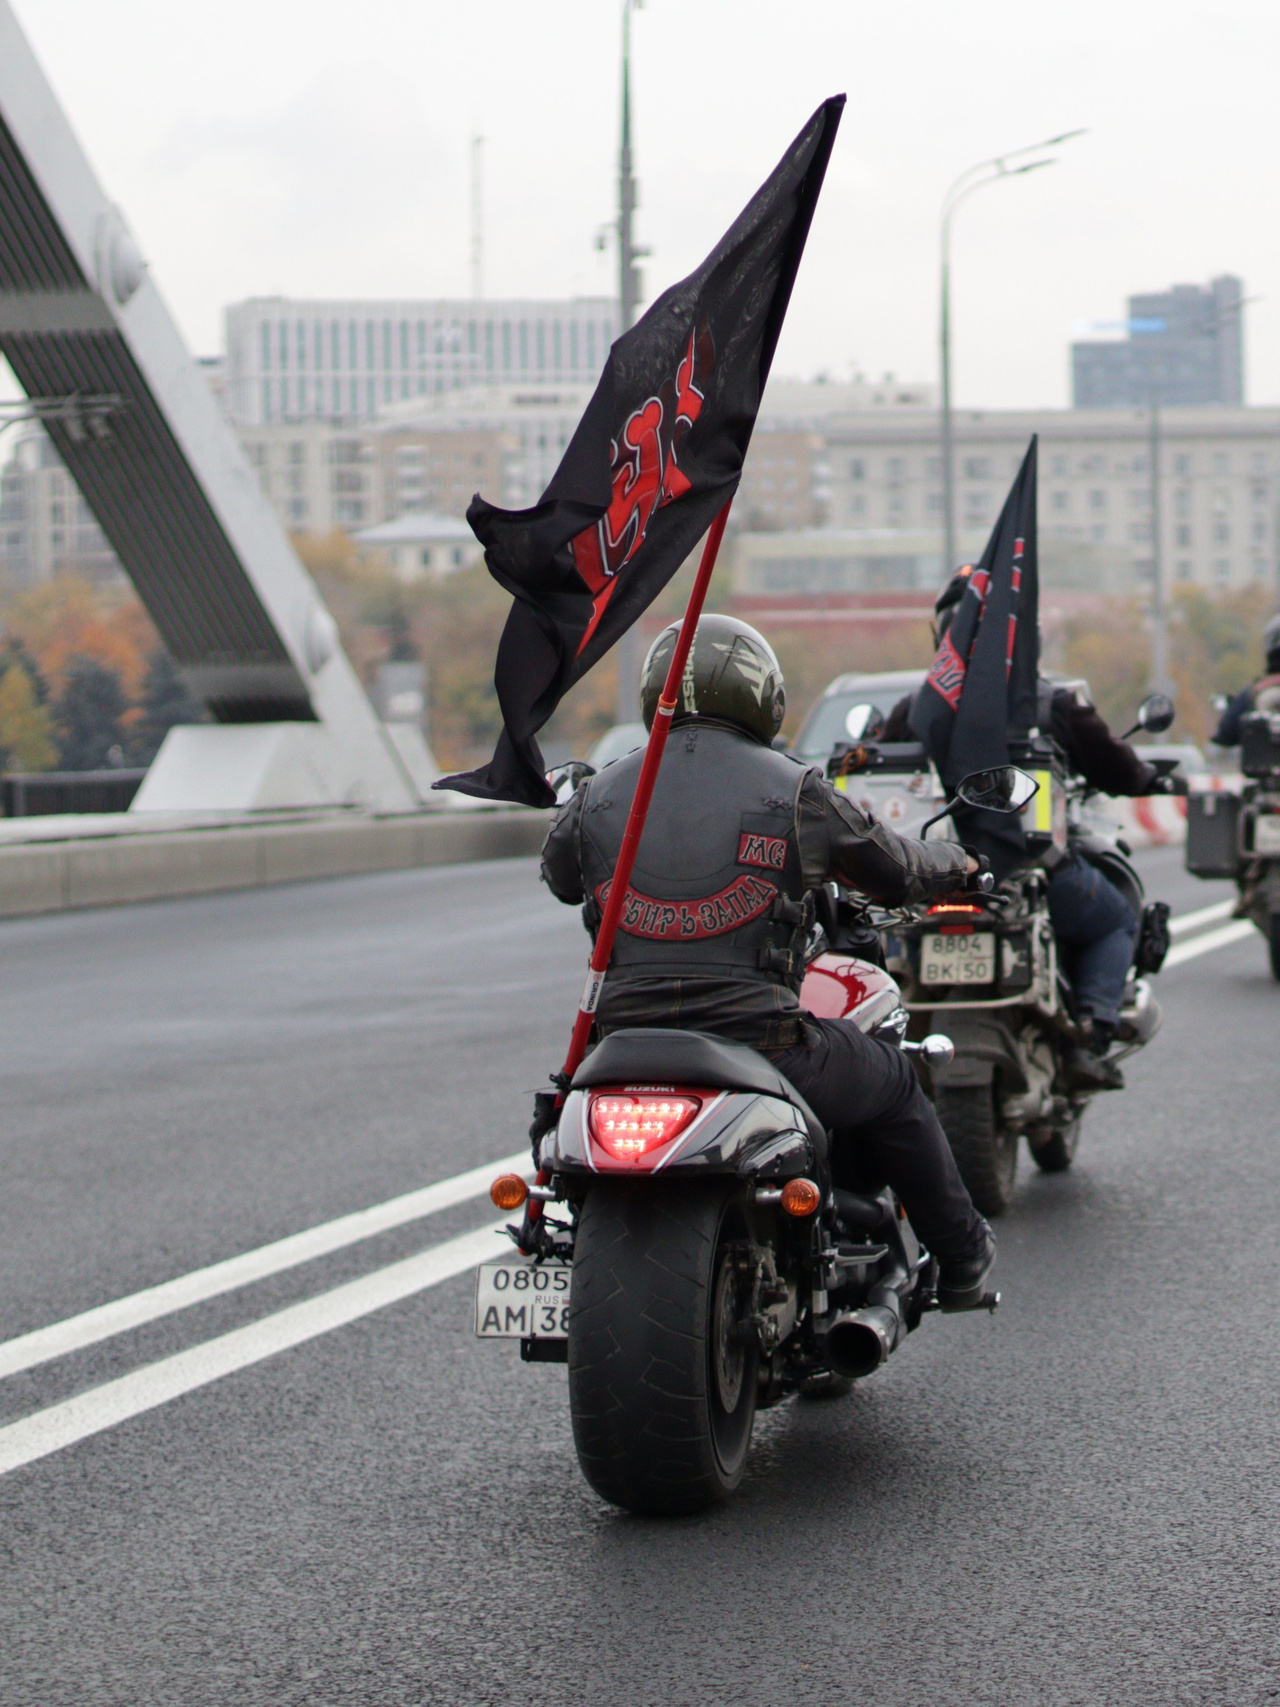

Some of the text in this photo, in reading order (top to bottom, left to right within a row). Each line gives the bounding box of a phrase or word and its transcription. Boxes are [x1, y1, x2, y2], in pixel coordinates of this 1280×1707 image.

[932, 937, 981, 953] 8804
[963, 963, 987, 979] 50
[586, 982, 599, 1011] GRINDA
[493, 1269, 568, 1291] 0805
[535, 1295, 560, 1304] RUS
